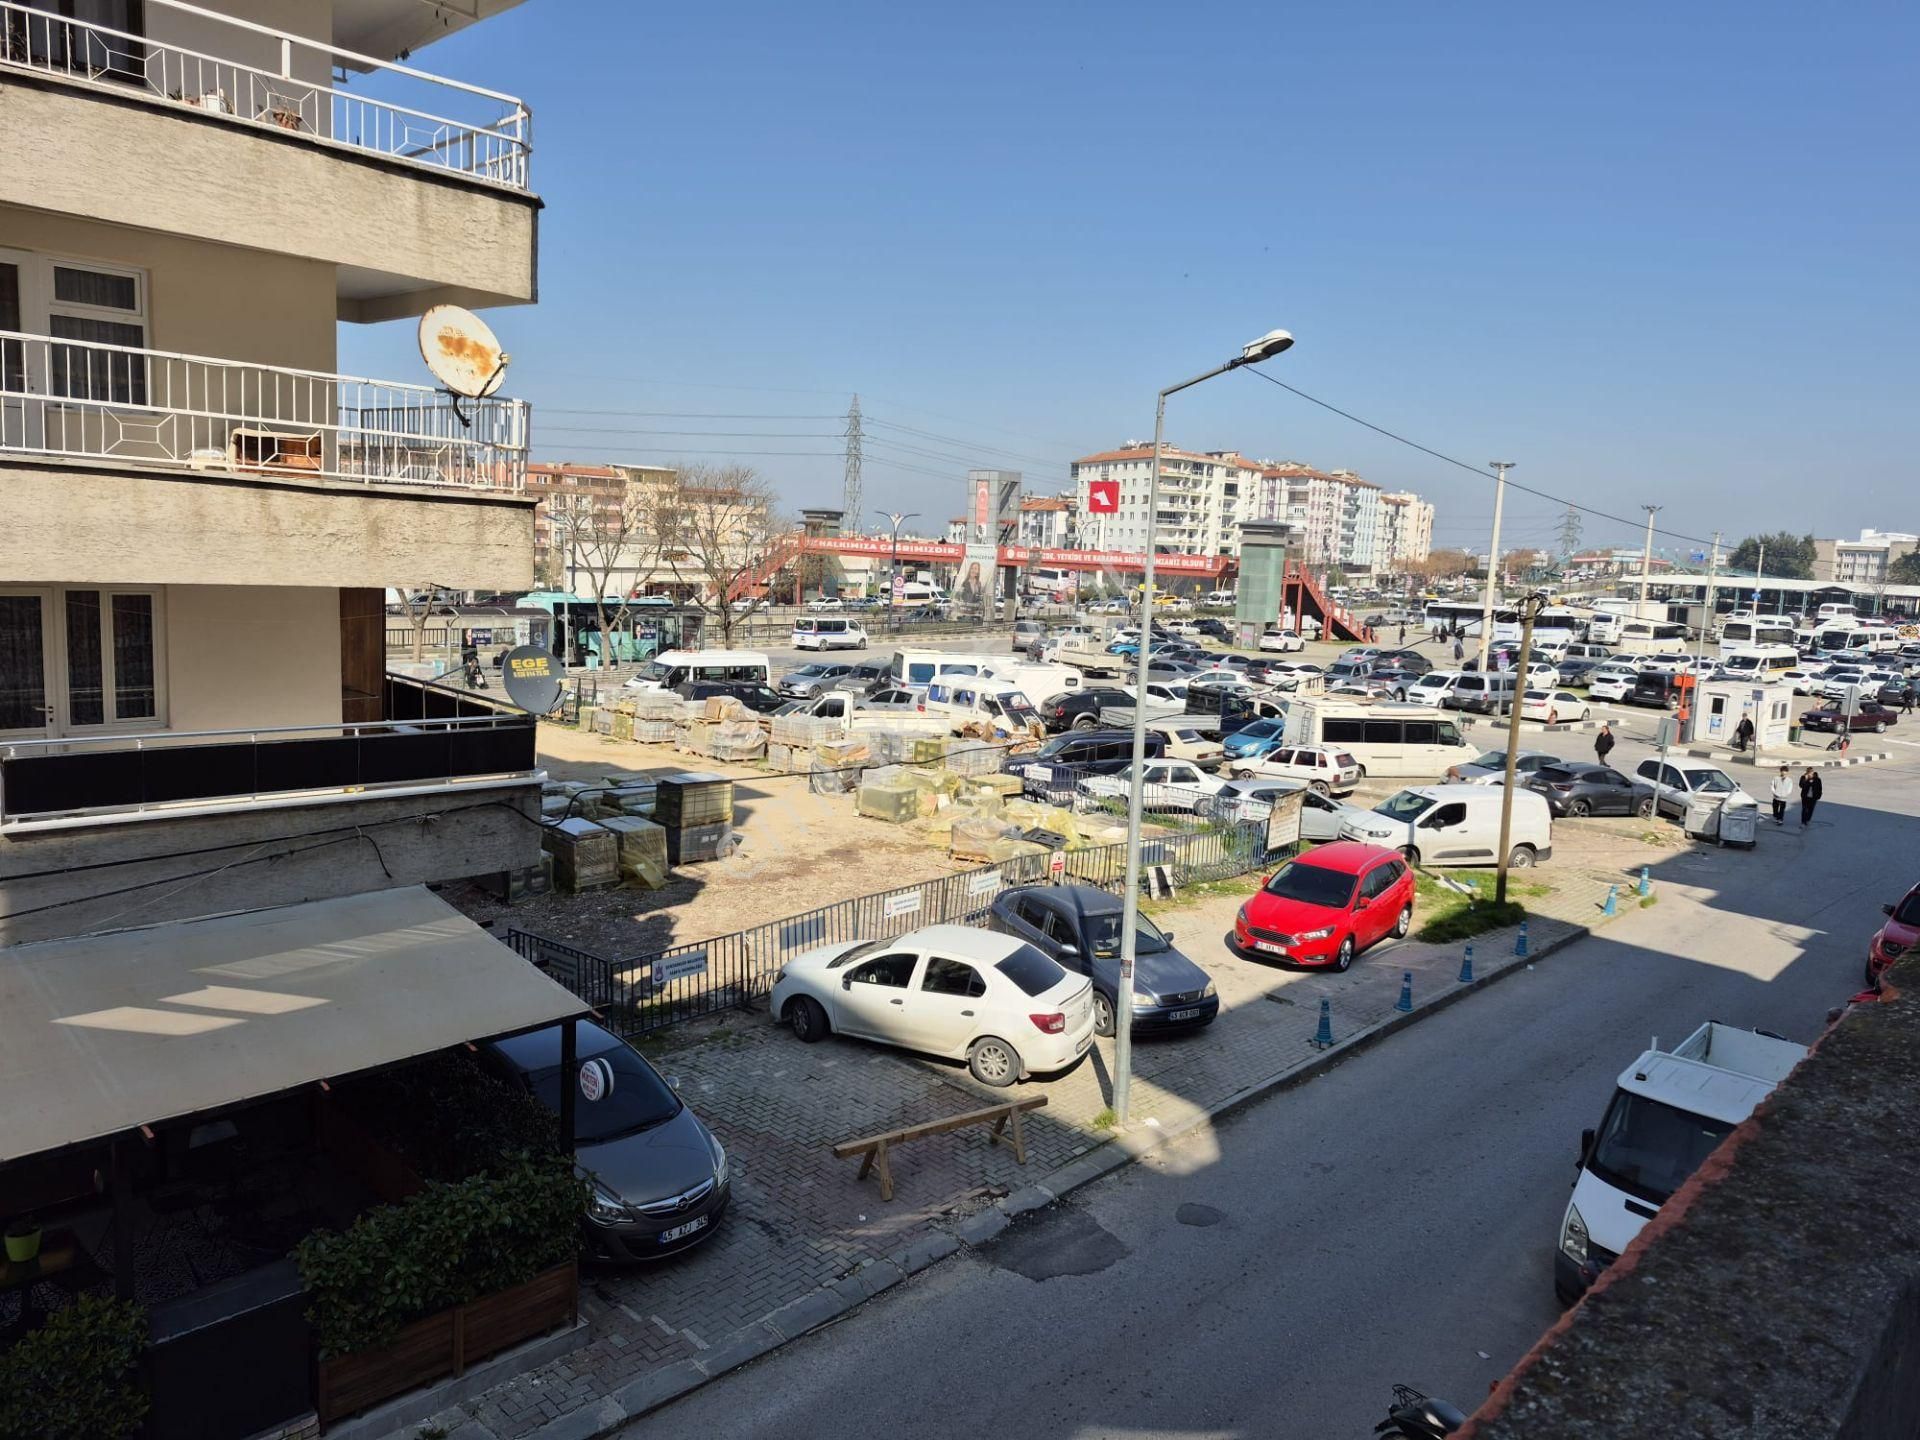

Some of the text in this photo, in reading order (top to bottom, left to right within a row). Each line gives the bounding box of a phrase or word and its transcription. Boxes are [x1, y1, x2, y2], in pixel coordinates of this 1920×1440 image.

[818, 540, 877, 551] HALKIMIZA
[1181, 559, 1204, 568] OLSUN
[511, 657, 549, 669] EGE
